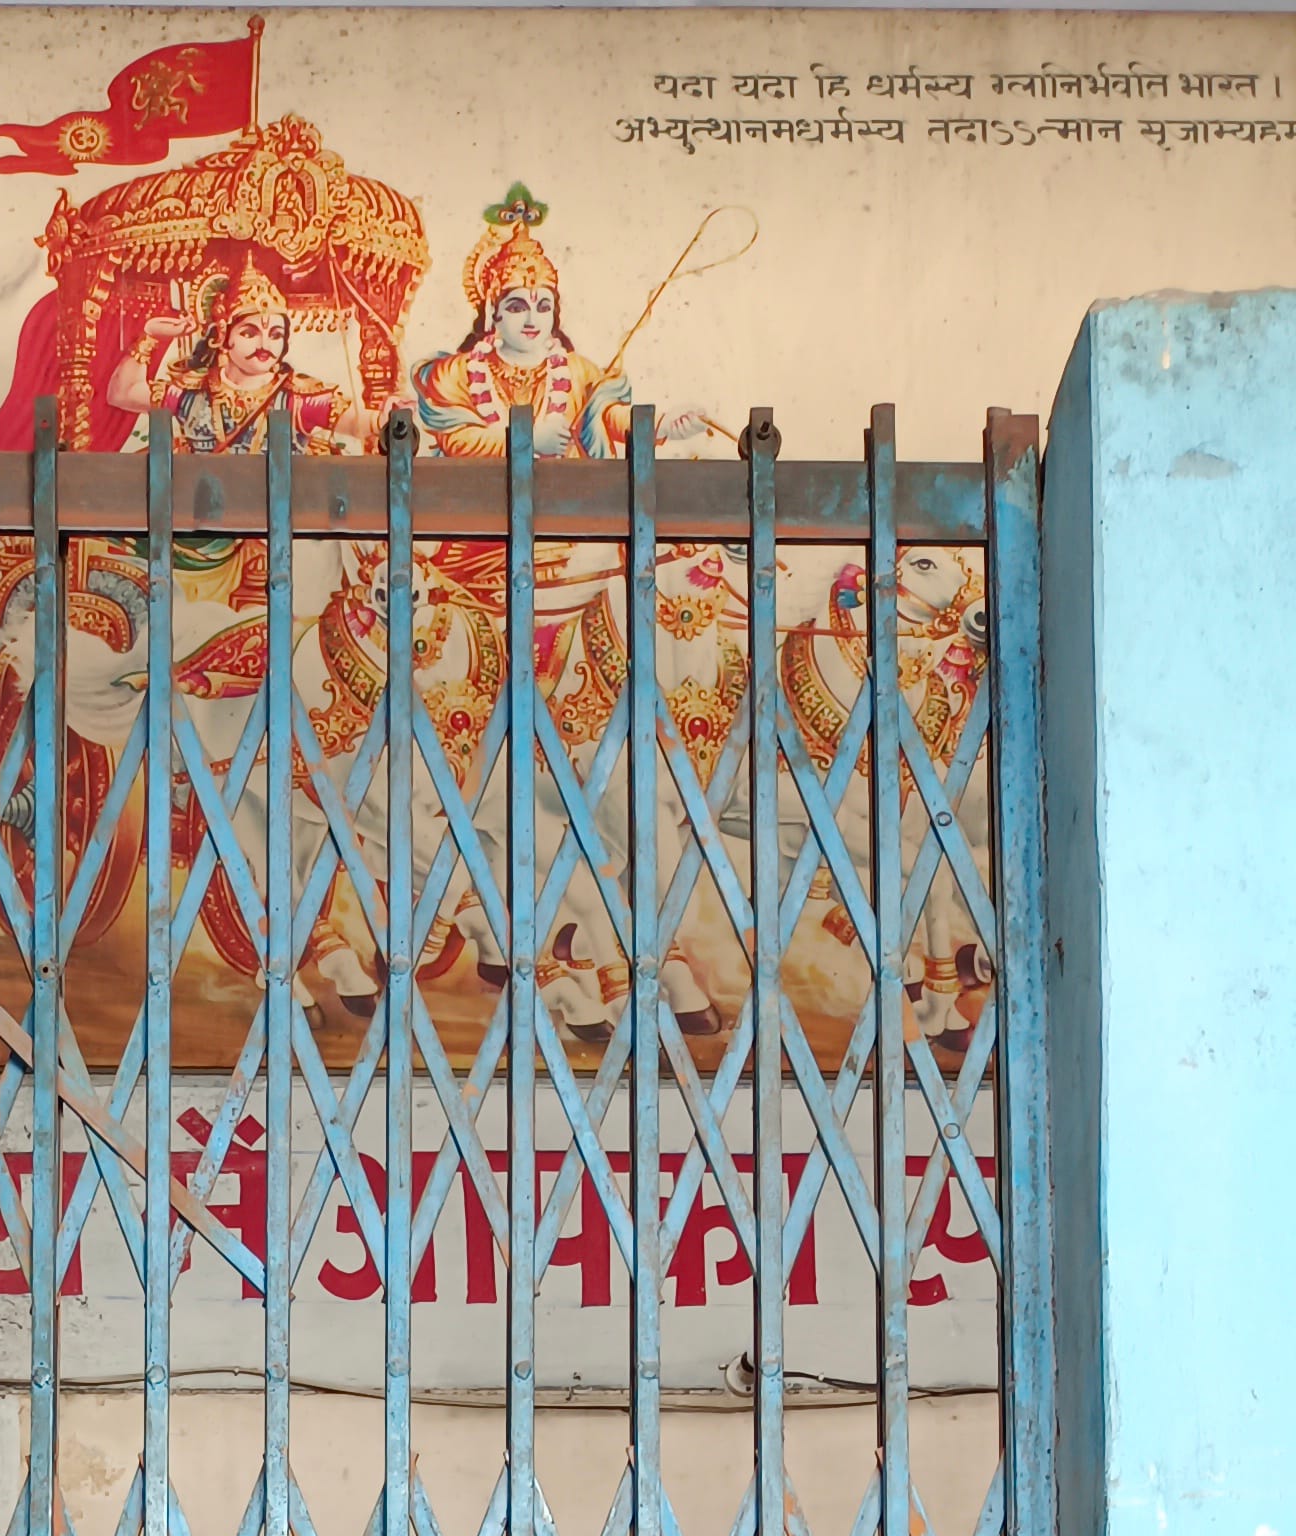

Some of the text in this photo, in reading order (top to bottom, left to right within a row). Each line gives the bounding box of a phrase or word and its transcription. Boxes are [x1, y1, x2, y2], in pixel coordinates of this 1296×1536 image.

[654, 74, 718, 99] यदा
[732, 74, 798, 99] यदा
[809, 62, 851, 99] हि
[866, 64, 975, 100] धर्मस्य
[318, 1150, 820, 1308] आपका
